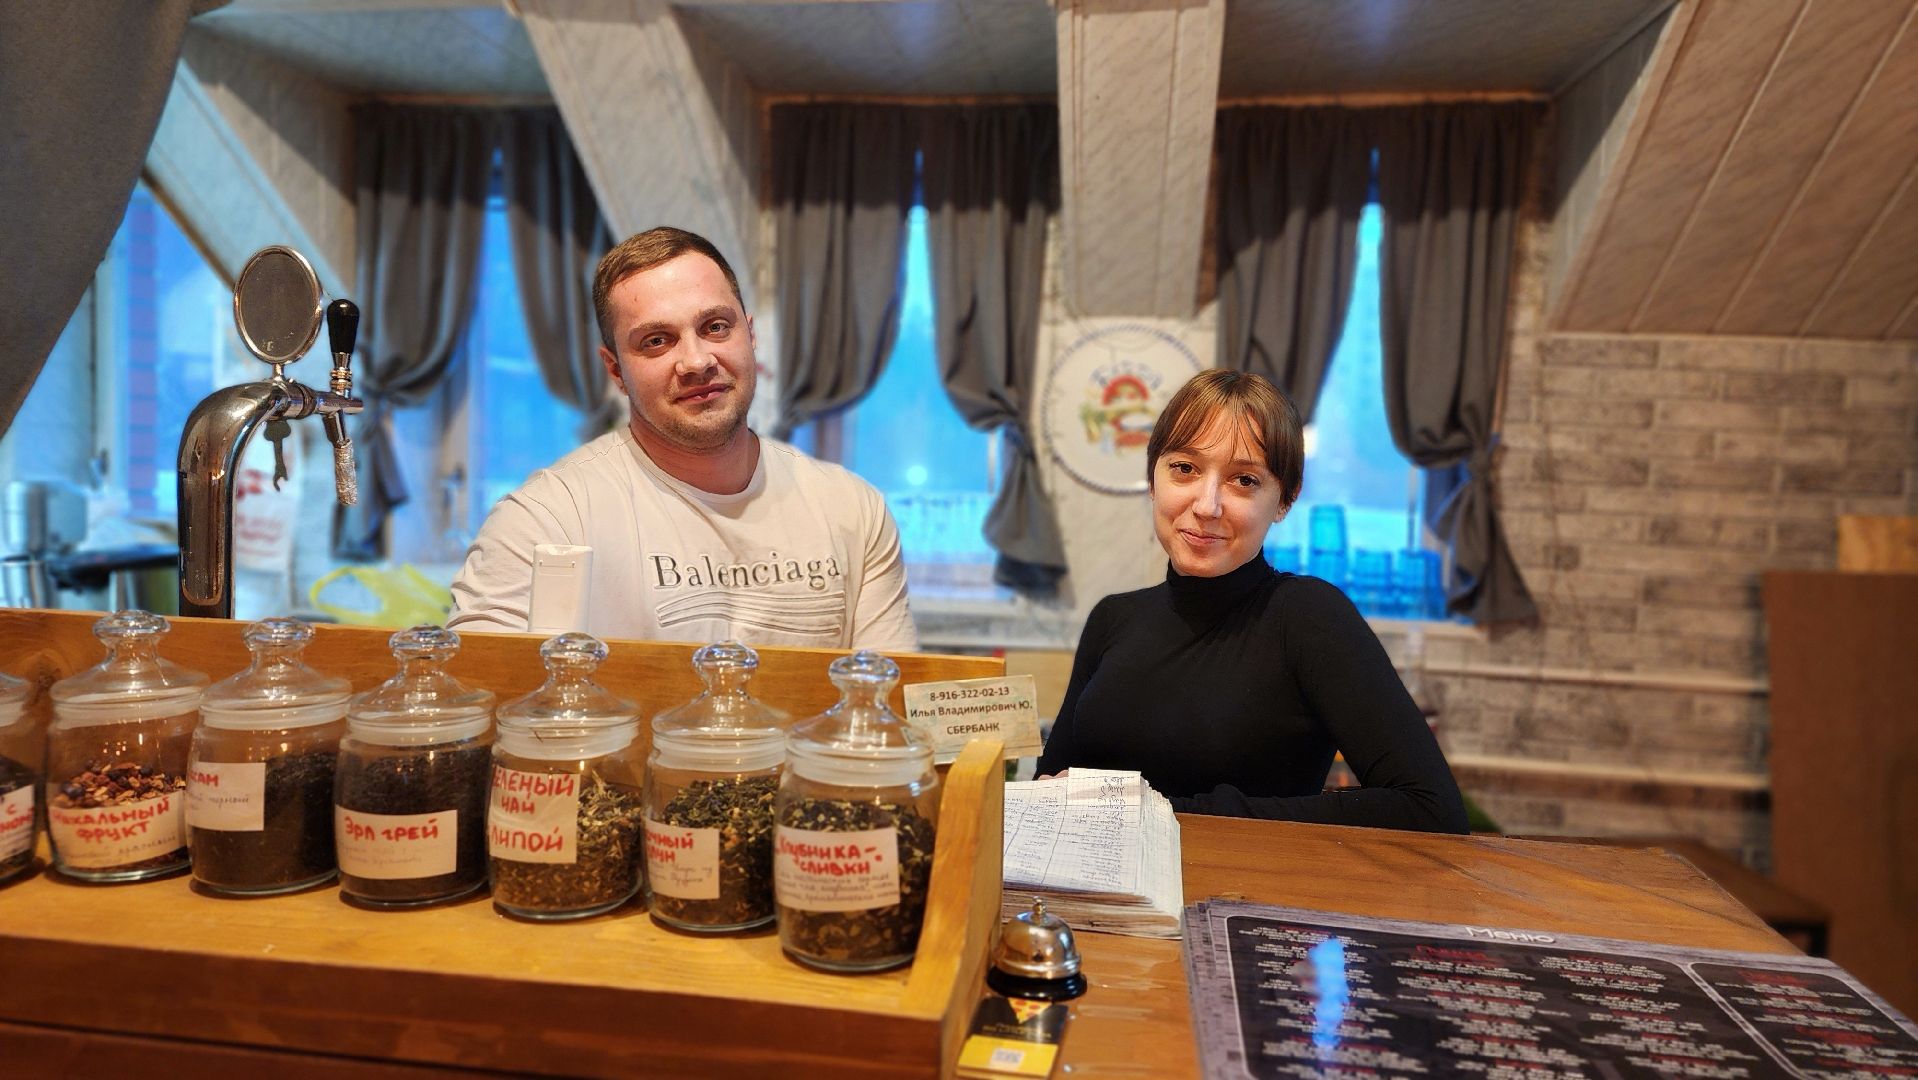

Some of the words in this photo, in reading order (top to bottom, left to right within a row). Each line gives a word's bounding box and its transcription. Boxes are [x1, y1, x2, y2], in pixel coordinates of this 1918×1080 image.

[648, 552, 840, 590] Balenciaga
[929, 686, 1010, 702] 8-916-322-02-13
[910, 708, 936, 718] Илья
[938, 702, 1017, 716] Владимирович
[1018, 700, 1033, 710] Ю.
[946, 722, 1001, 735] СБЕРБАНК
